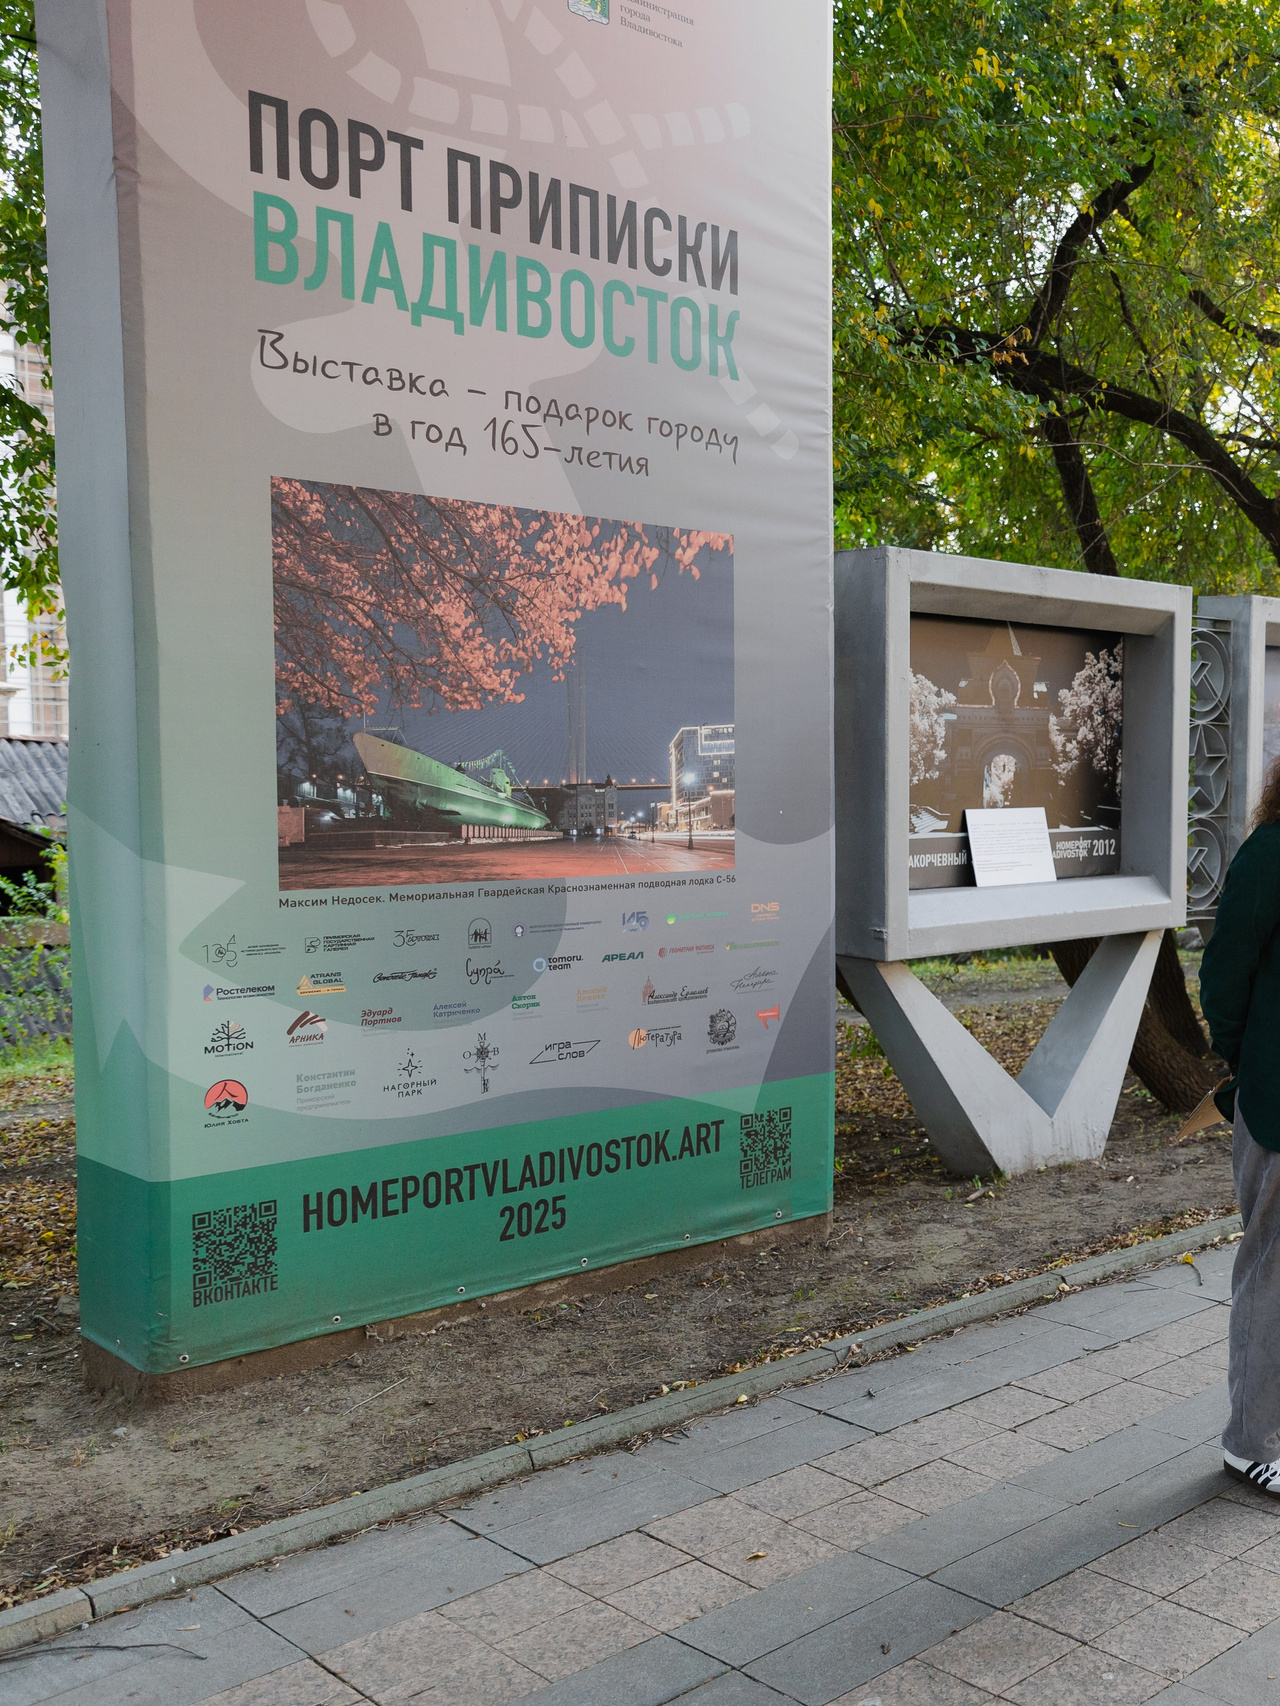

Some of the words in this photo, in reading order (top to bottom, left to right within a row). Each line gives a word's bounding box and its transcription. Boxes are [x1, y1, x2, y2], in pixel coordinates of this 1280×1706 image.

[620, 4, 651, 22] города
[626, 0, 694, 26] министрация
[620, 16, 683, 48] Владивостока
[248, 90, 424, 212] ПОРТ
[447, 147, 739, 296] ПРИПИСКИ
[253, 190, 740, 382] ВЛАДИВОСТОК
[257, 328, 450, 398] Выставка
[504, 390, 634, 436] подарок
[647, 417, 739, 465] городу
[372, 413, 393, 437] в
[410, 420, 467, 456] год
[483, 416, 650, 477] 165-летия
[1053, 848, 1088, 859] ADIVOSTOK
[1056, 839, 1091, 850] HOMEPORT
[1093, 839, 1116, 856] 2012
[909, 850, 967, 868] АКОРЧЕВНЫЙ
[278, 898, 328, 908] Максим
[332, 894, 386, 906] Недосек.
[389, 889, 475, 903] Мемориальная
[477, 885, 546, 898] Гвардейская
[547, 880, 636, 895] Краснознаменная
[638, 877, 687, 890] подводная
[688, 876, 715, 887] лодка
[750, 902, 779, 913] DNS
[602, 951, 644, 962] АРЕАЛ
[216, 985, 275, 996] Ростелеком
[361, 1007, 393, 1018] Эдуард
[433, 1001, 466, 1011] Алексей
[361, 1016, 402, 1027] Портнов
[288, 1033, 325, 1044] АРНИКА
[545, 1039, 572, 1053] игра
[557, 1049, 585, 1061] слов
[296, 1069, 356, 1083] Константин
[296, 1080, 357, 1094] Богданенко
[383, 1078, 437, 1092] НАГОРНЫЙ
[397, 1089, 423, 1098] ПАРК
[303, 1119, 725, 1233] HOMEPORTVLADIVOSTOK.ART
[740, 1166, 792, 1190] ТЕЛЕГРАМ
[500, 1194, 567, 1242] 2025
[193, 1274, 278, 1308] ВКОНТАКТЕ
